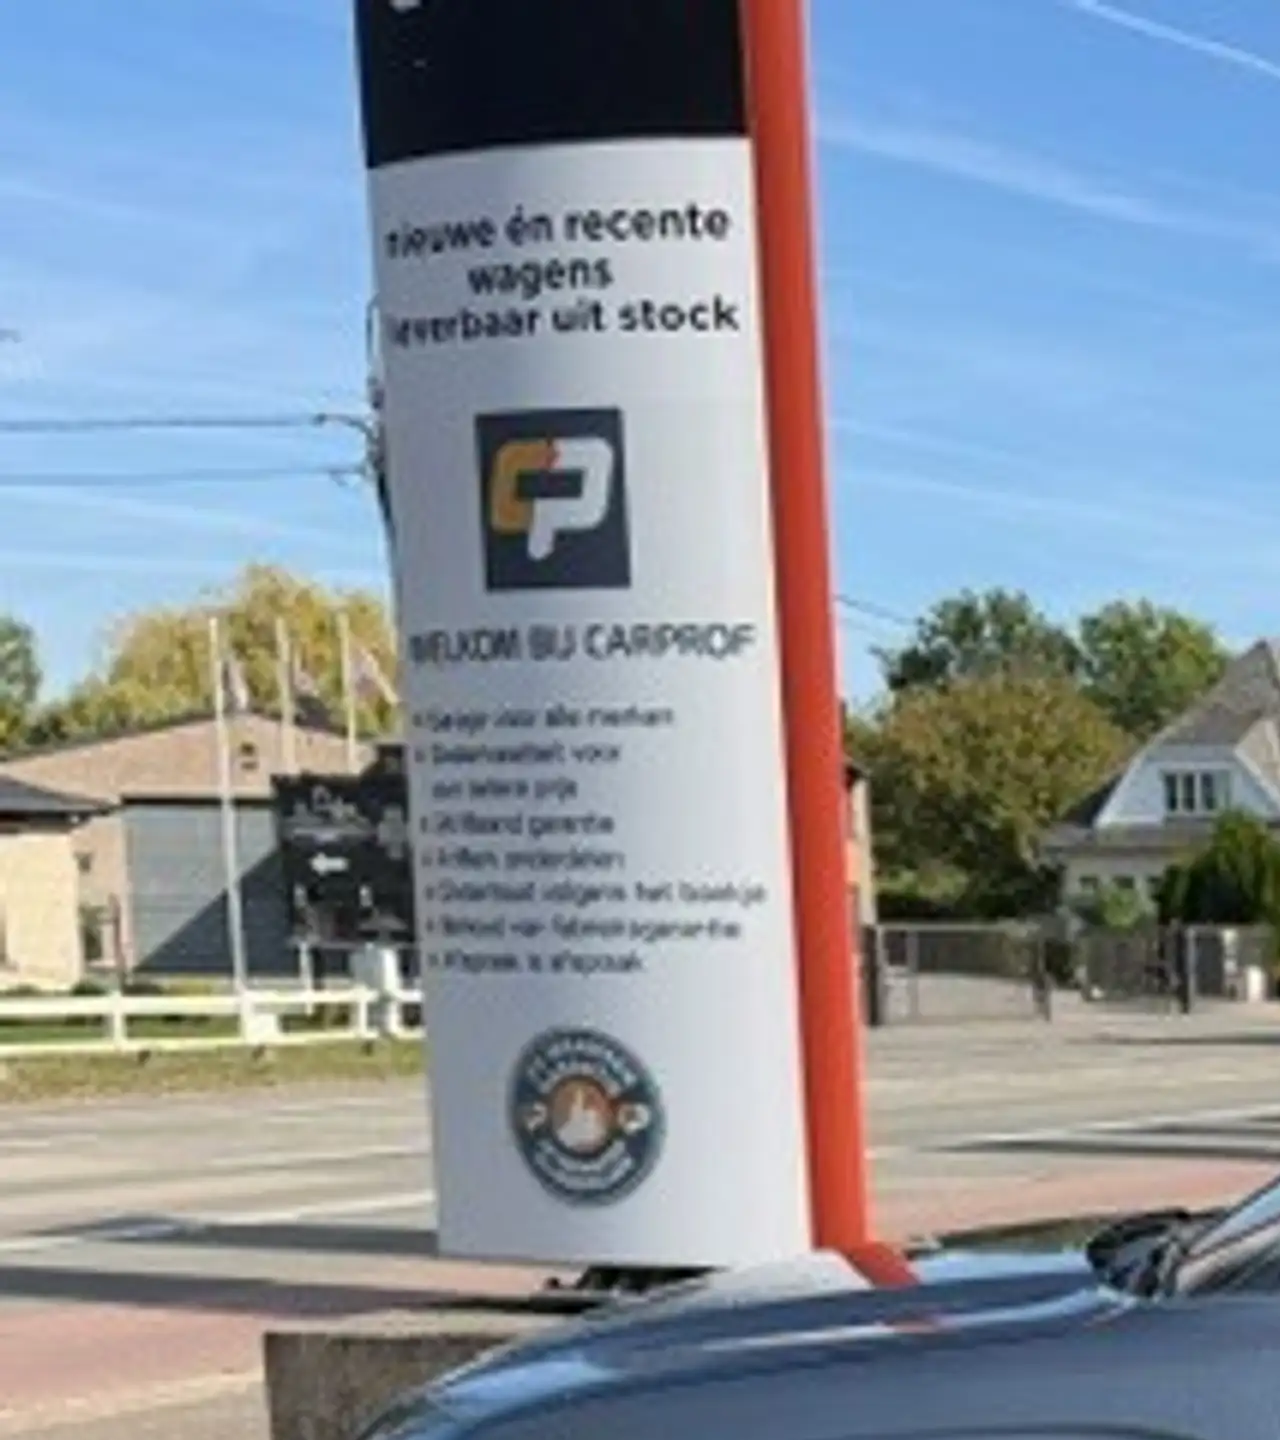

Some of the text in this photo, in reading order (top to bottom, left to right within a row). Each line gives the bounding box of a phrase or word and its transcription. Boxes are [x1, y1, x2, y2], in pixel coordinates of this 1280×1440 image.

[565, 200, 731, 244] recente
[467, 256, 615, 301] wagens
[551, 298, 608, 334] uit
[617, 294, 741, 336] stock
[586, 621, 758, 663] CARPROF
